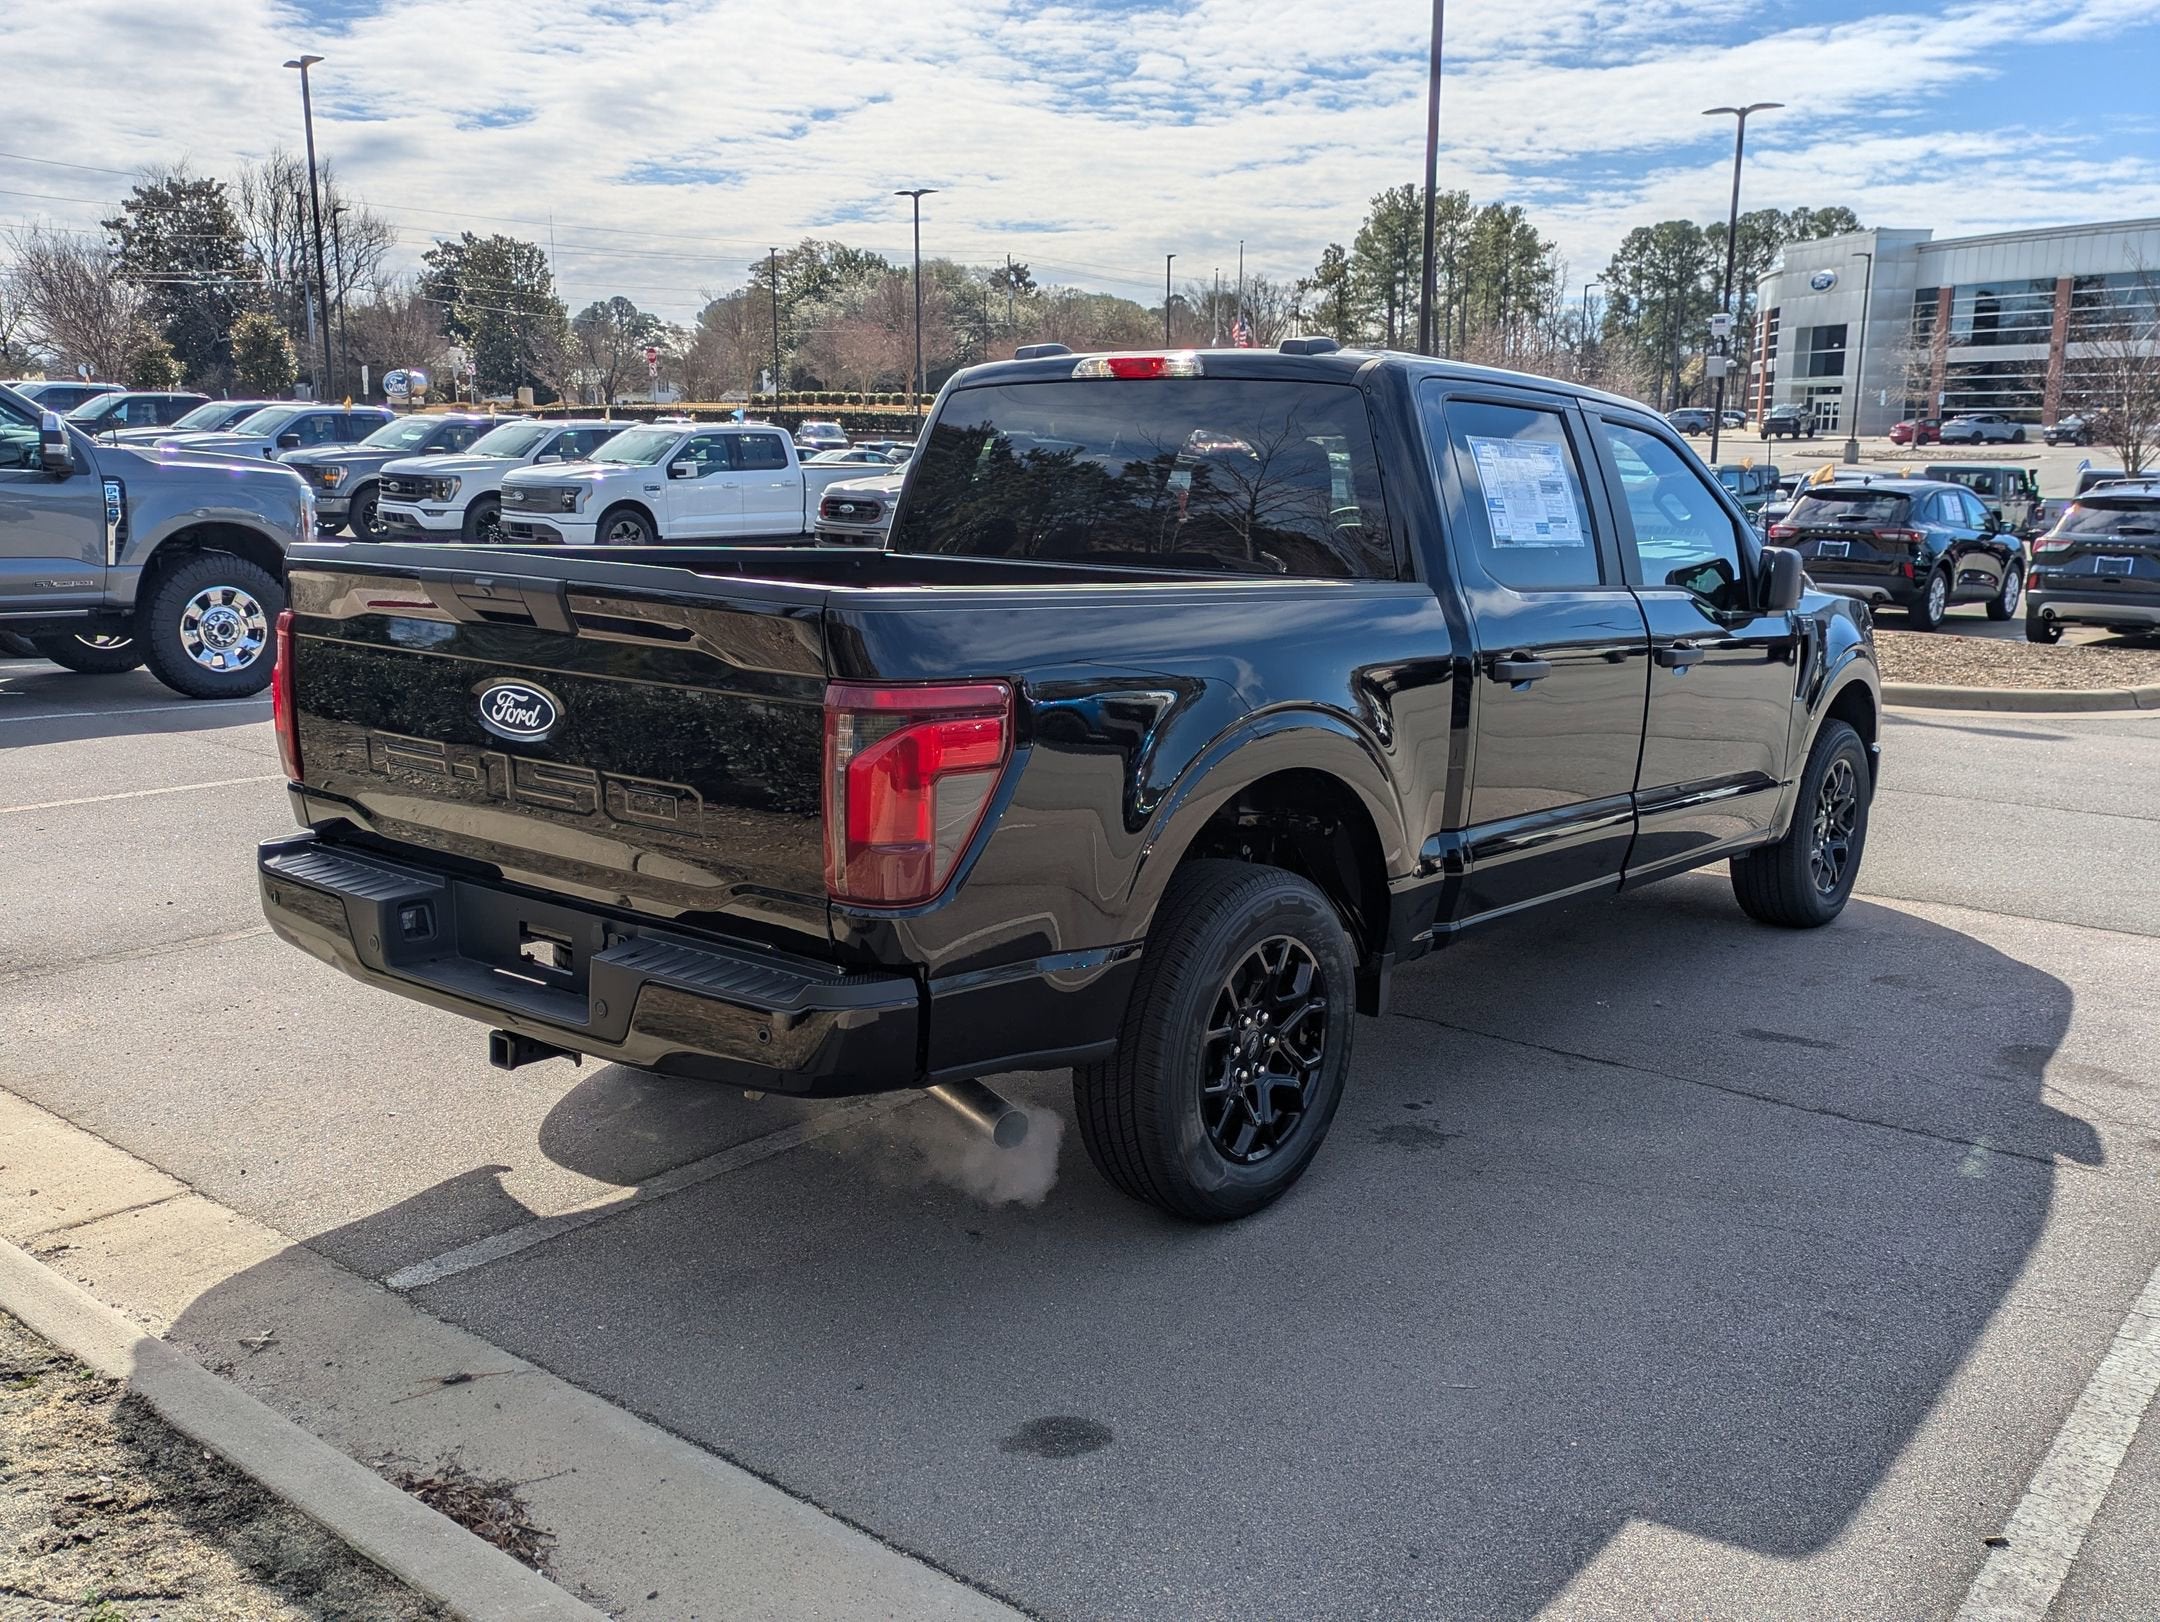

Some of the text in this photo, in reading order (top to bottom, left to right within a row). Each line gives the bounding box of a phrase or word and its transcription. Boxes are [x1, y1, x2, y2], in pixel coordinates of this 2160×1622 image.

[388, 376, 408, 392] Ford
[492, 690, 541, 727] Ford
[367, 729, 703, 839] F-150
